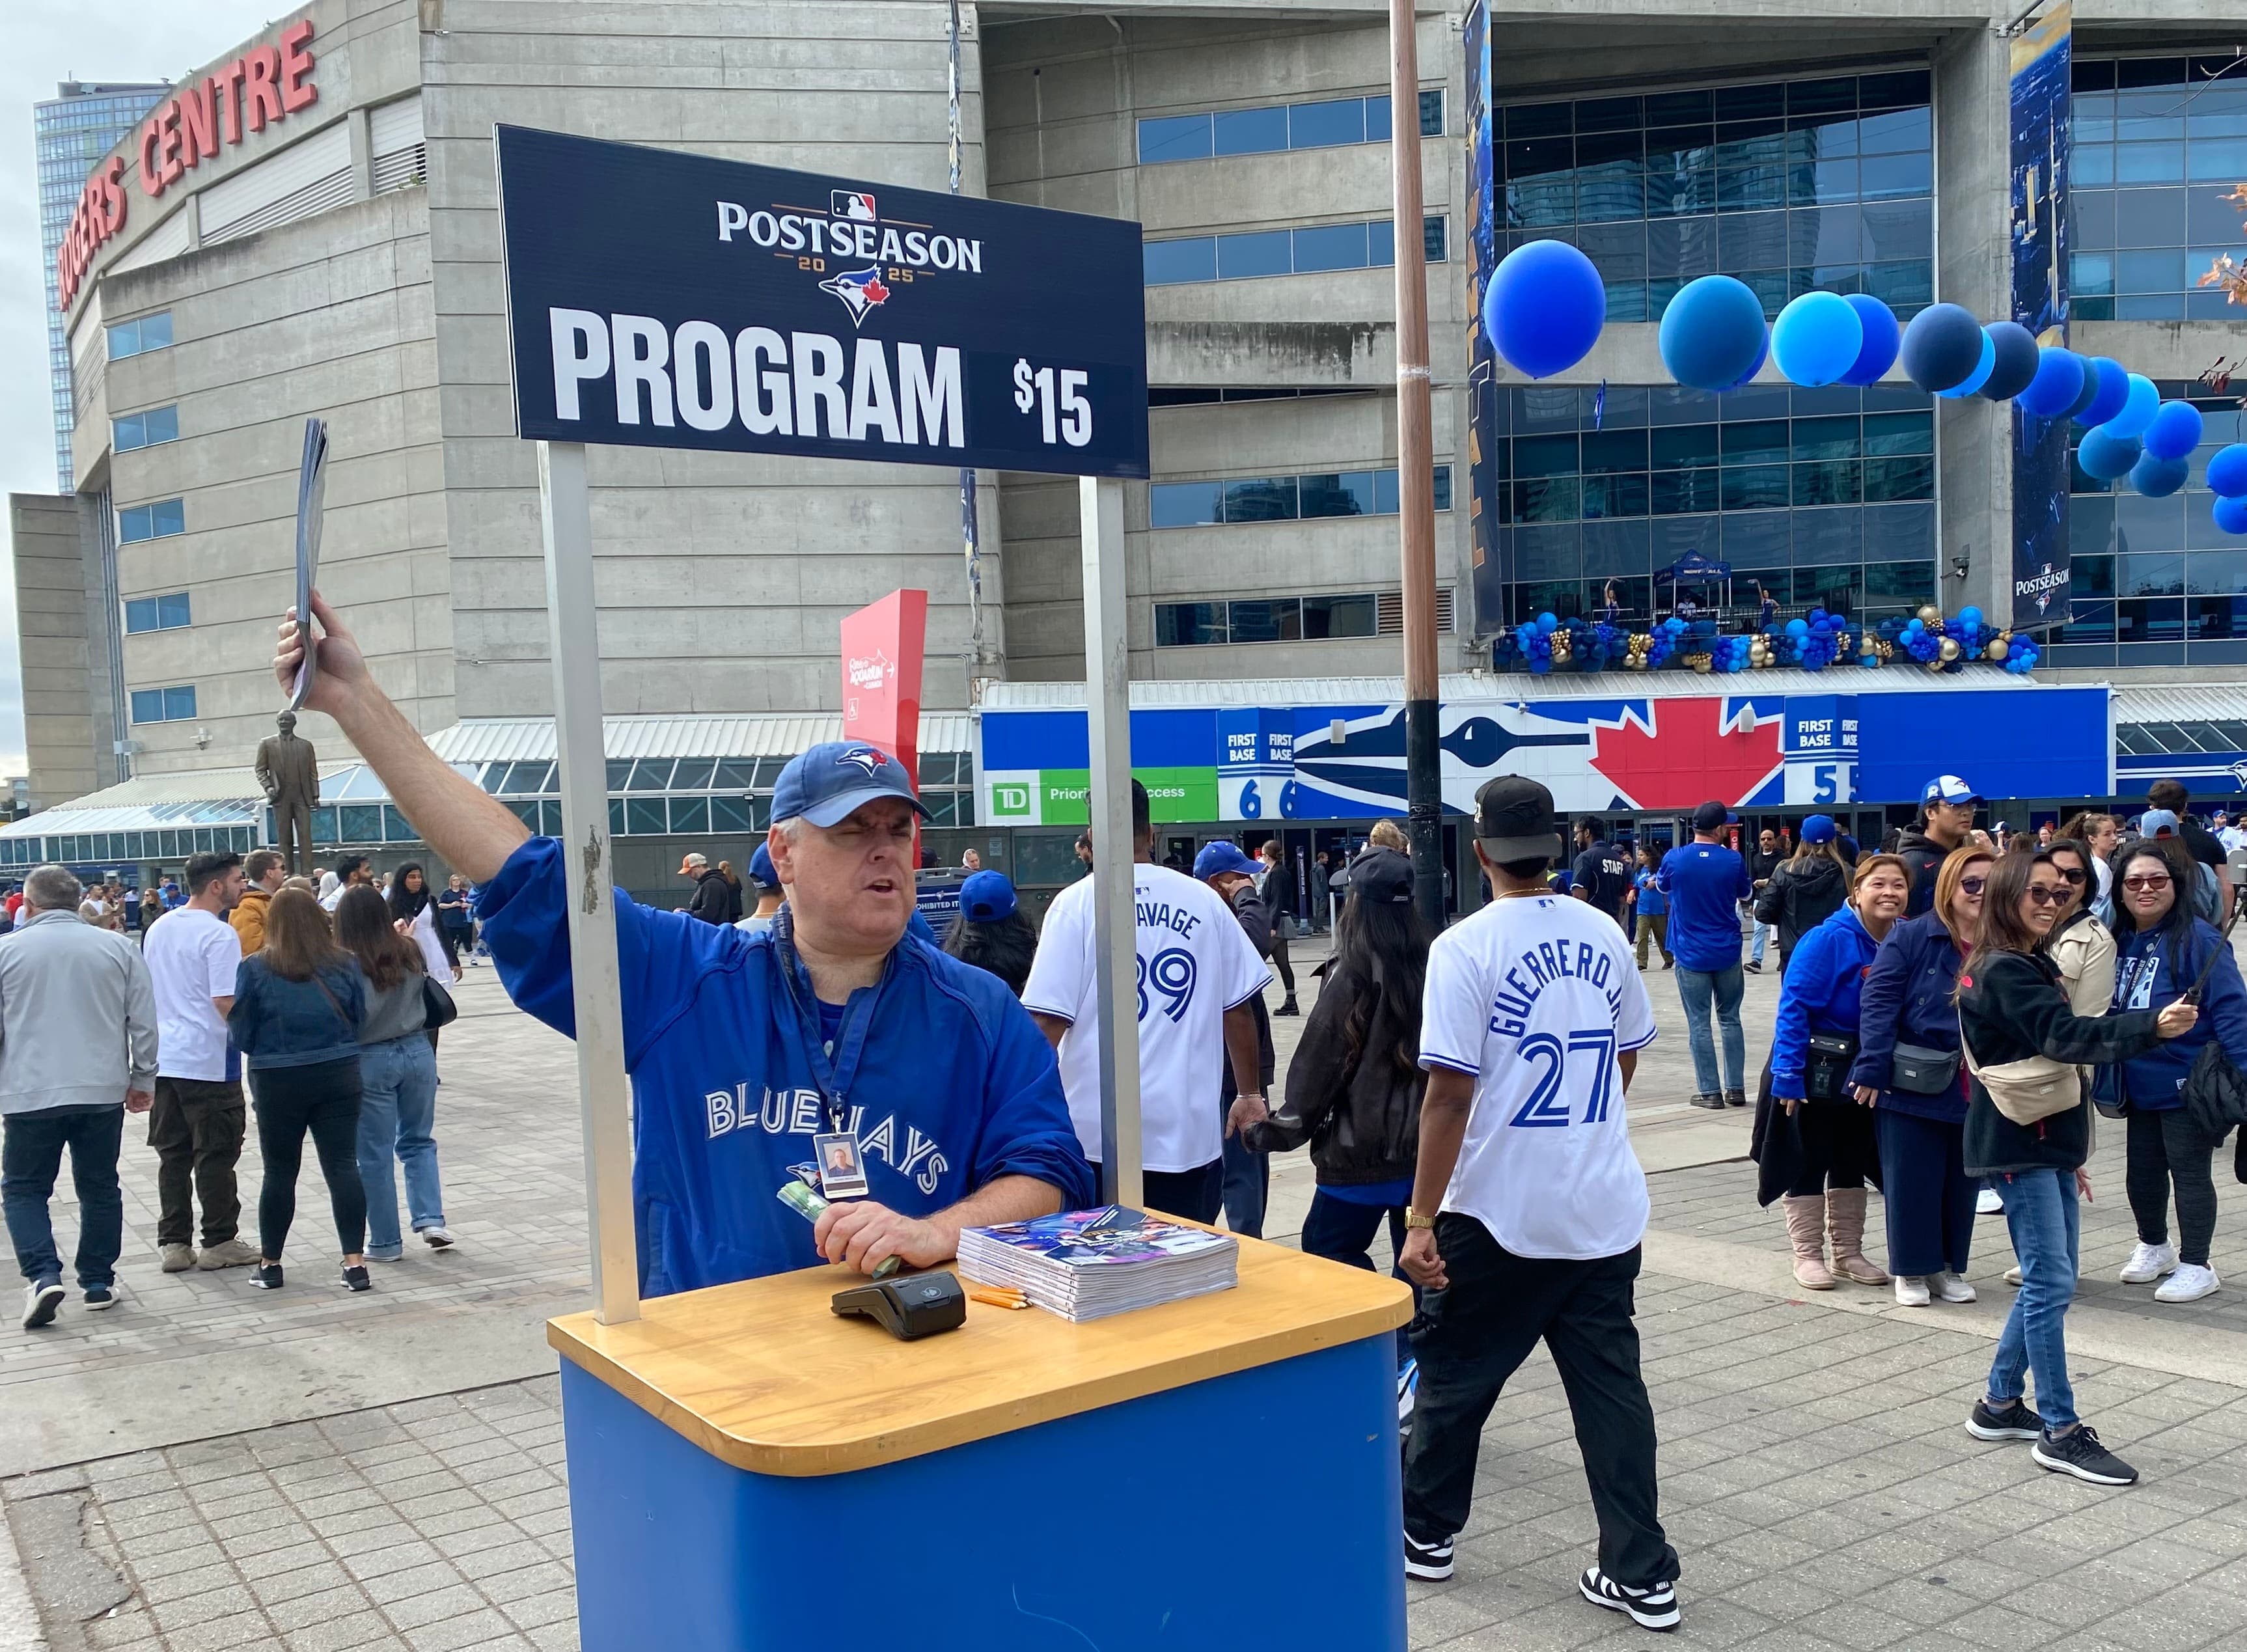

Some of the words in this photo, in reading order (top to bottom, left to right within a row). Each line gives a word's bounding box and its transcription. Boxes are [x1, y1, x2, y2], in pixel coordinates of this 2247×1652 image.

[58, 156, 128, 312] ROGERS
[139, 19, 318, 198] CENTRE
[715, 200, 982, 274] POSTSEASON
[798, 256, 825, 273] 20
[887, 268, 914, 283] 25
[549, 306, 965, 448] PROGRAM
[1013, 357, 1092, 447] $15
[2015, 568, 2070, 596] POSTSEASON
[1798, 719, 1834, 733] FIRST
[1841, 719, 1859, 732] FIRST
[1228, 733, 1257, 747] FIRST
[1269, 733, 1293, 747] FIRST
[1799, 734, 1832, 747] BASE
[1842, 734, 1858, 746] BASE
[1229, 748, 1256, 762] BASE
[1270, 748, 1293, 761] BASE
[1050, 788, 1088, 800] Priori
[1148, 787, 1185, 799] ccess
[1813, 765, 1837, 805] 5
[996, 788, 1027, 809] TD
[1239, 778, 1261, 819] 6
[916, 901, 951, 911] OHIBITED
[1136, 902, 1201, 941] AVAGE
[1489, 938, 1611, 1038] GUERRERO
[1509, 1028, 1616, 1127] 27
[704, 1081, 821, 1140] BLUE
[847, 1104, 949, 1196] JAYS
